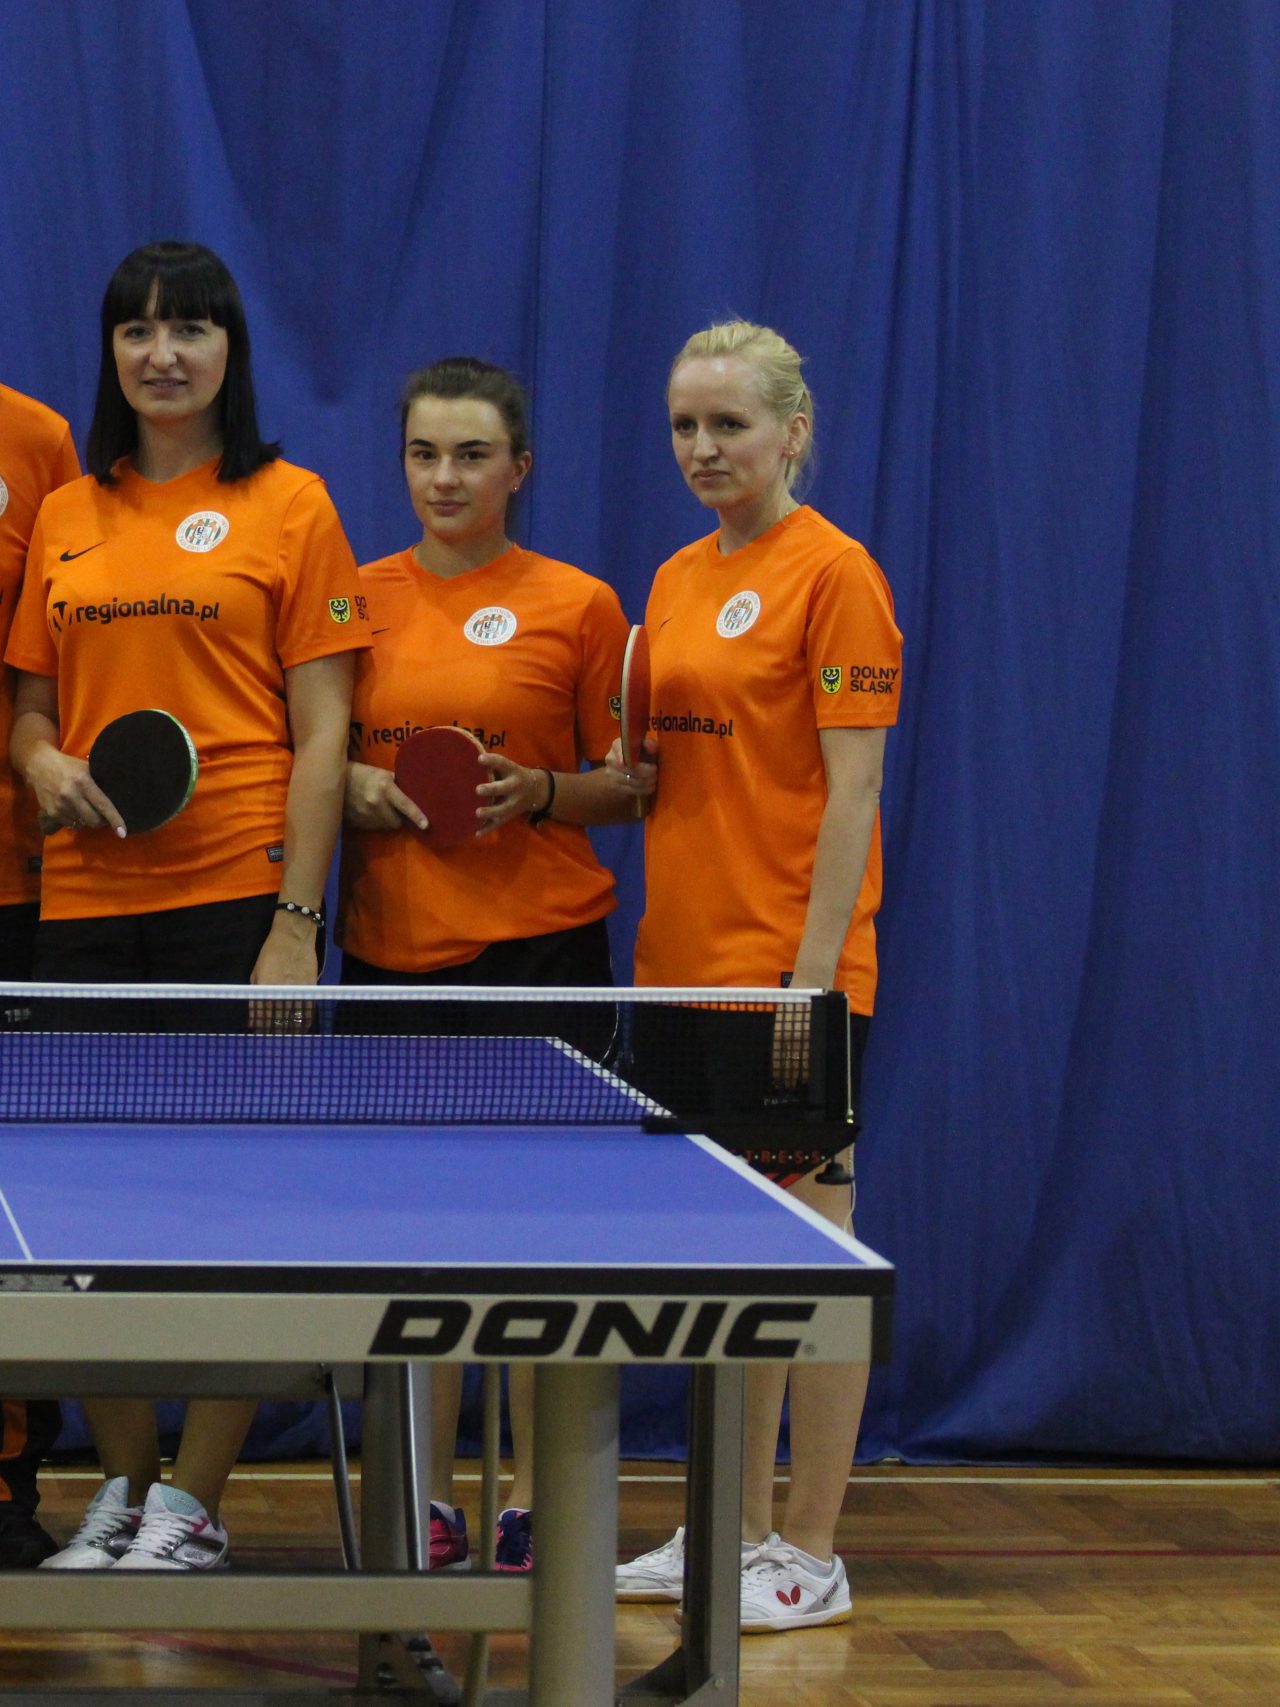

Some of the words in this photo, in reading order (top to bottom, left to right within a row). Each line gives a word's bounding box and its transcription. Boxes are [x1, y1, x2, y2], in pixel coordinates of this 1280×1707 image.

[75, 593, 220, 625] regionalna.pl
[850, 665, 899, 680] DOLNY
[367, 1300, 819, 1358] DONIC
